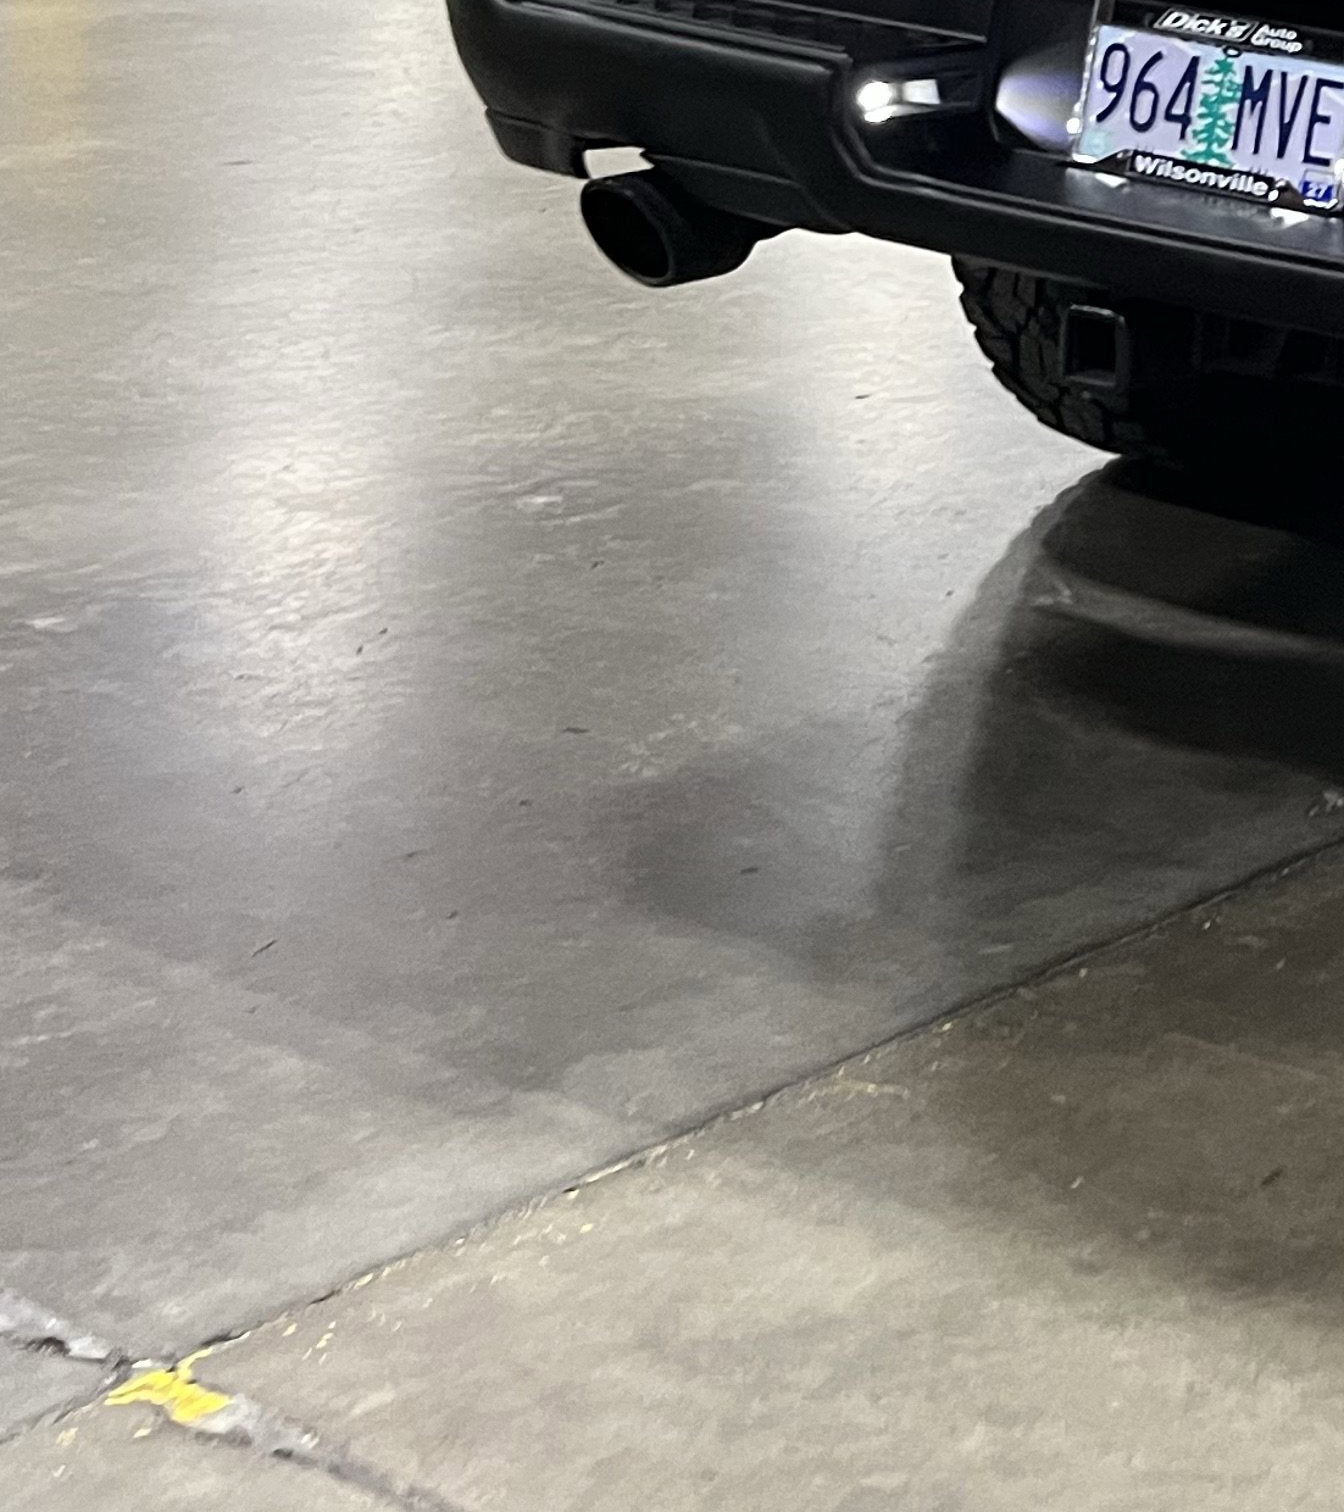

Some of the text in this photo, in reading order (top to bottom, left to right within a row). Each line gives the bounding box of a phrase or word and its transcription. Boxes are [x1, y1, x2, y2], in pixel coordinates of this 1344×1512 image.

[1160, 10, 1251, 39] Dick's
[1252, 23, 1298, 41] Auto
[1251, 34, 1303, 54] Group
[1096, 43, 1200, 140] 964
[1133, 153, 1269, 197] Wilsonville
[1305, 182, 1329, 199] 27
